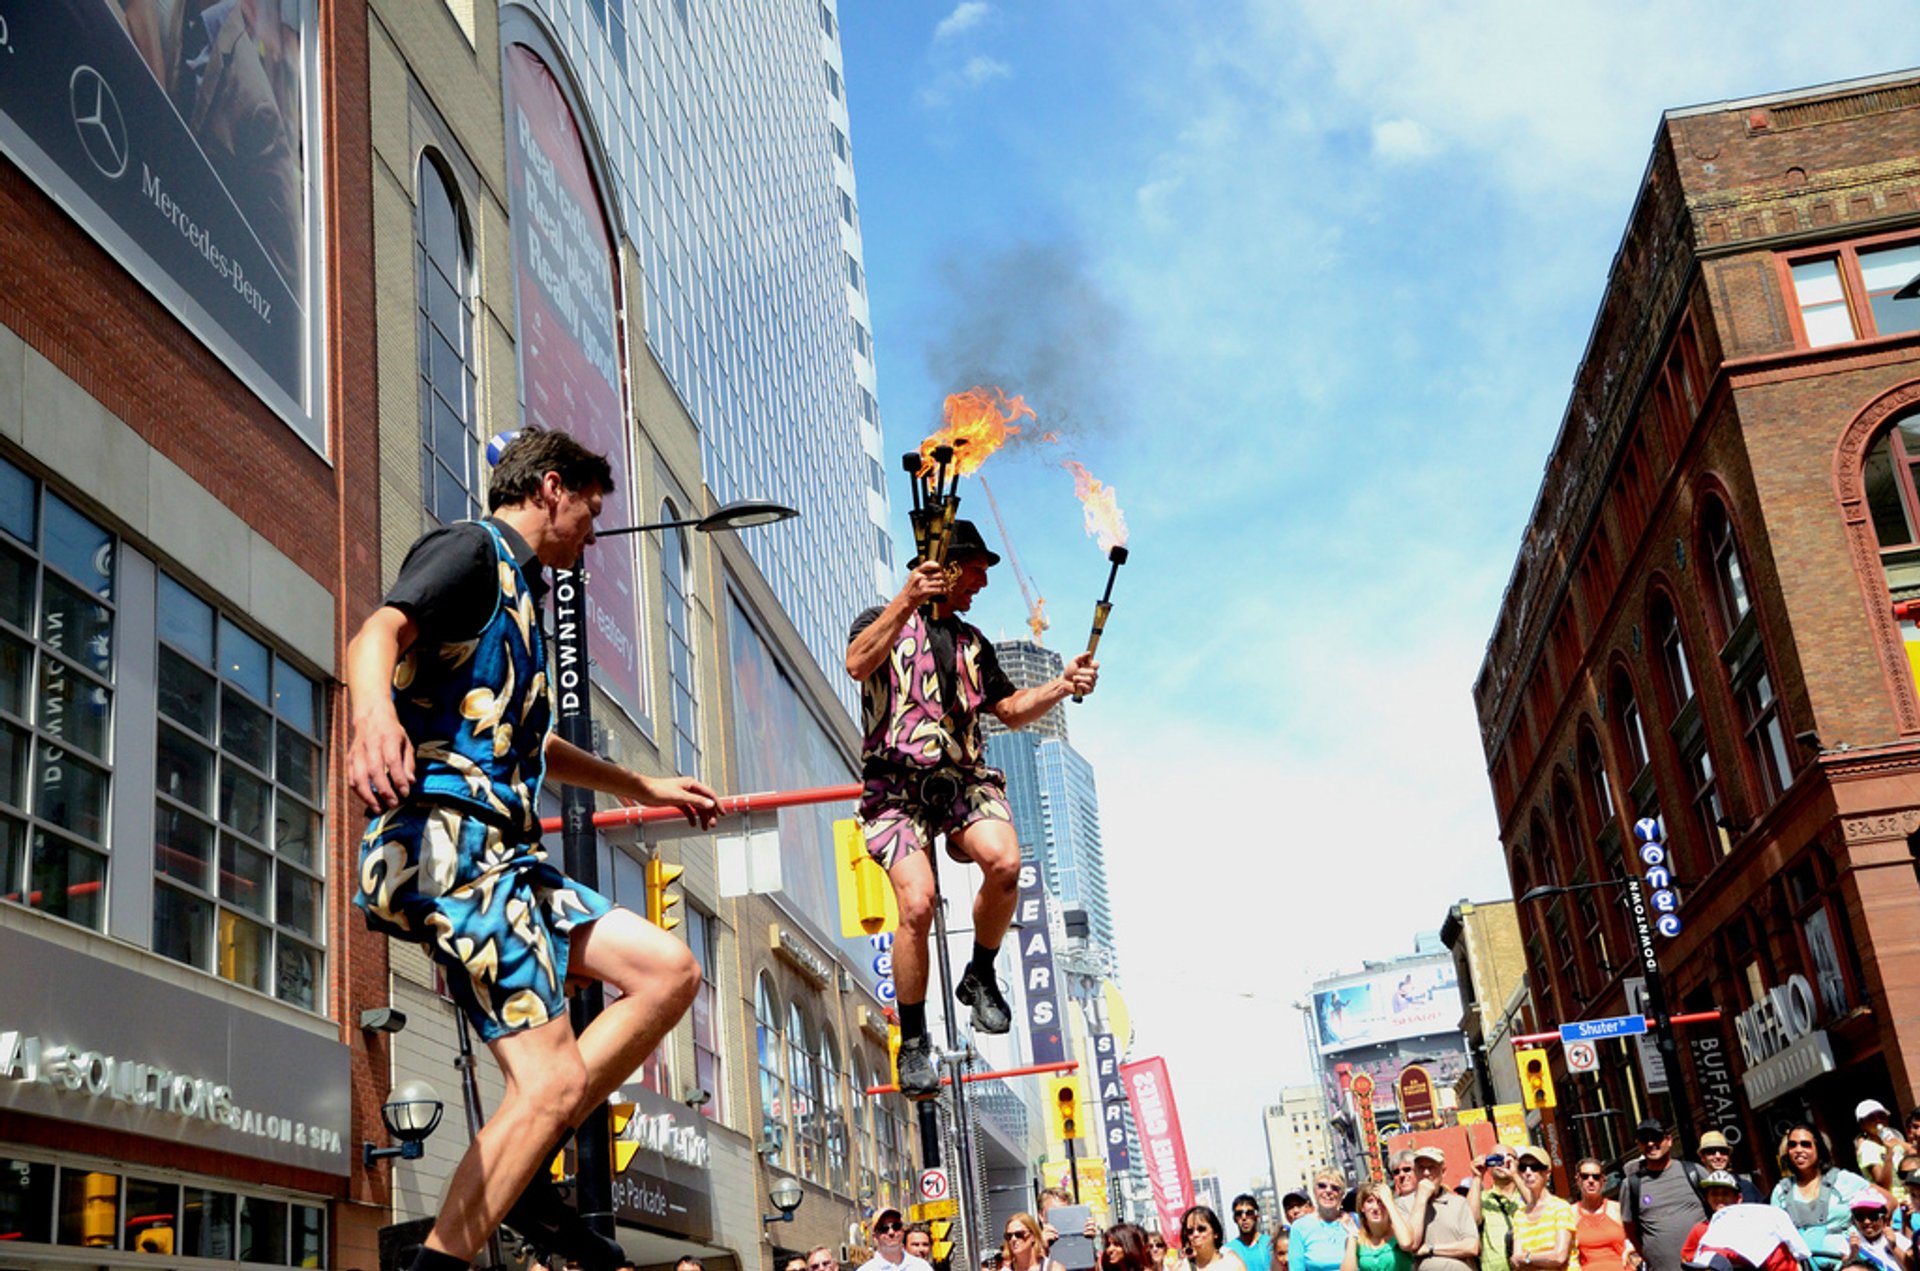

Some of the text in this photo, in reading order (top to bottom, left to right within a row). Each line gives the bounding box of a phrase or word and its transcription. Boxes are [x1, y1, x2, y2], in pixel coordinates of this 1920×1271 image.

[517, 105, 557, 203] Real
[142, 161, 272, 325] Mercedes-Benz
[524, 165, 565, 262] Real
[528, 222, 580, 340] Really
[557, 568, 579, 715] DOWNTO
[1629, 881, 1656, 972] DOWNTOWN
[1636, 818, 1681, 938] Yonge
[872, 931, 898, 1004] nge
[1018, 865, 1055, 1025] SEARS
[1579, 1021, 1620, 1037] Shuter
[0, 1030, 342, 1154] AL SOLUTIONS SALON & SPA
[1097, 1036, 1124, 1145] SEARS
[1700, 1037, 1743, 1146] BUFFALO
[611, 1177, 667, 1216] ge Parkade
